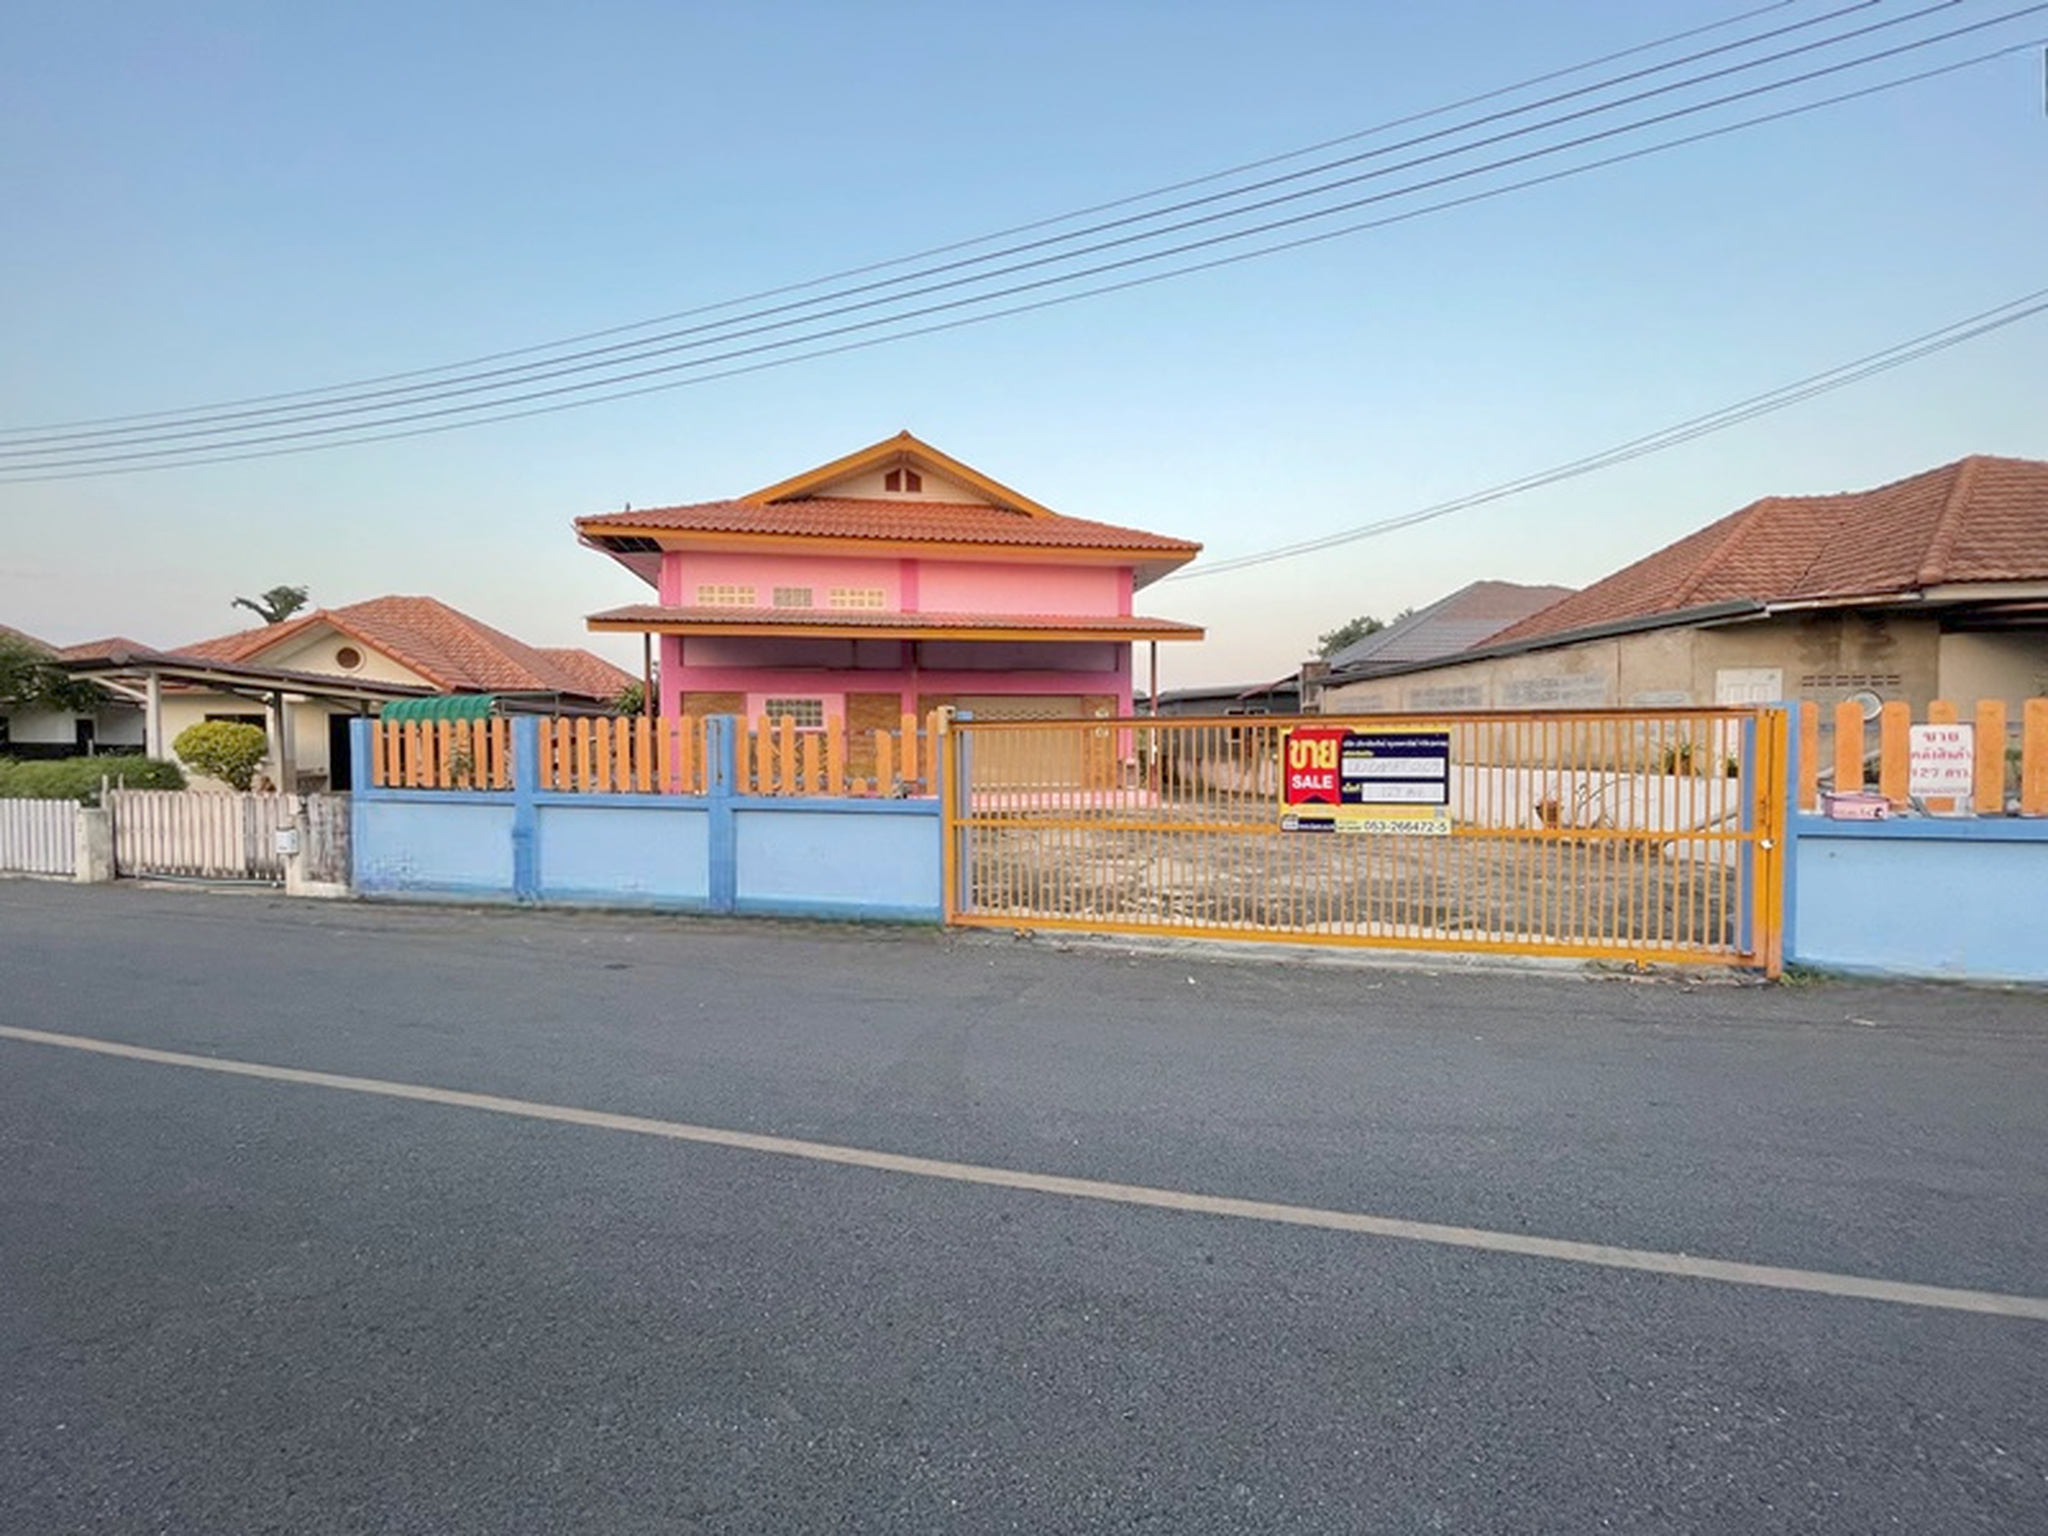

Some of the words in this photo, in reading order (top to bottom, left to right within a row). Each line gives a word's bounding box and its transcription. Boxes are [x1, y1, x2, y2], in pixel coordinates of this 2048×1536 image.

[1922, 731, 1960, 743] ขาย
[1289, 738, 1337, 769] ขาย
[1292, 774, 1333, 790] SALE
